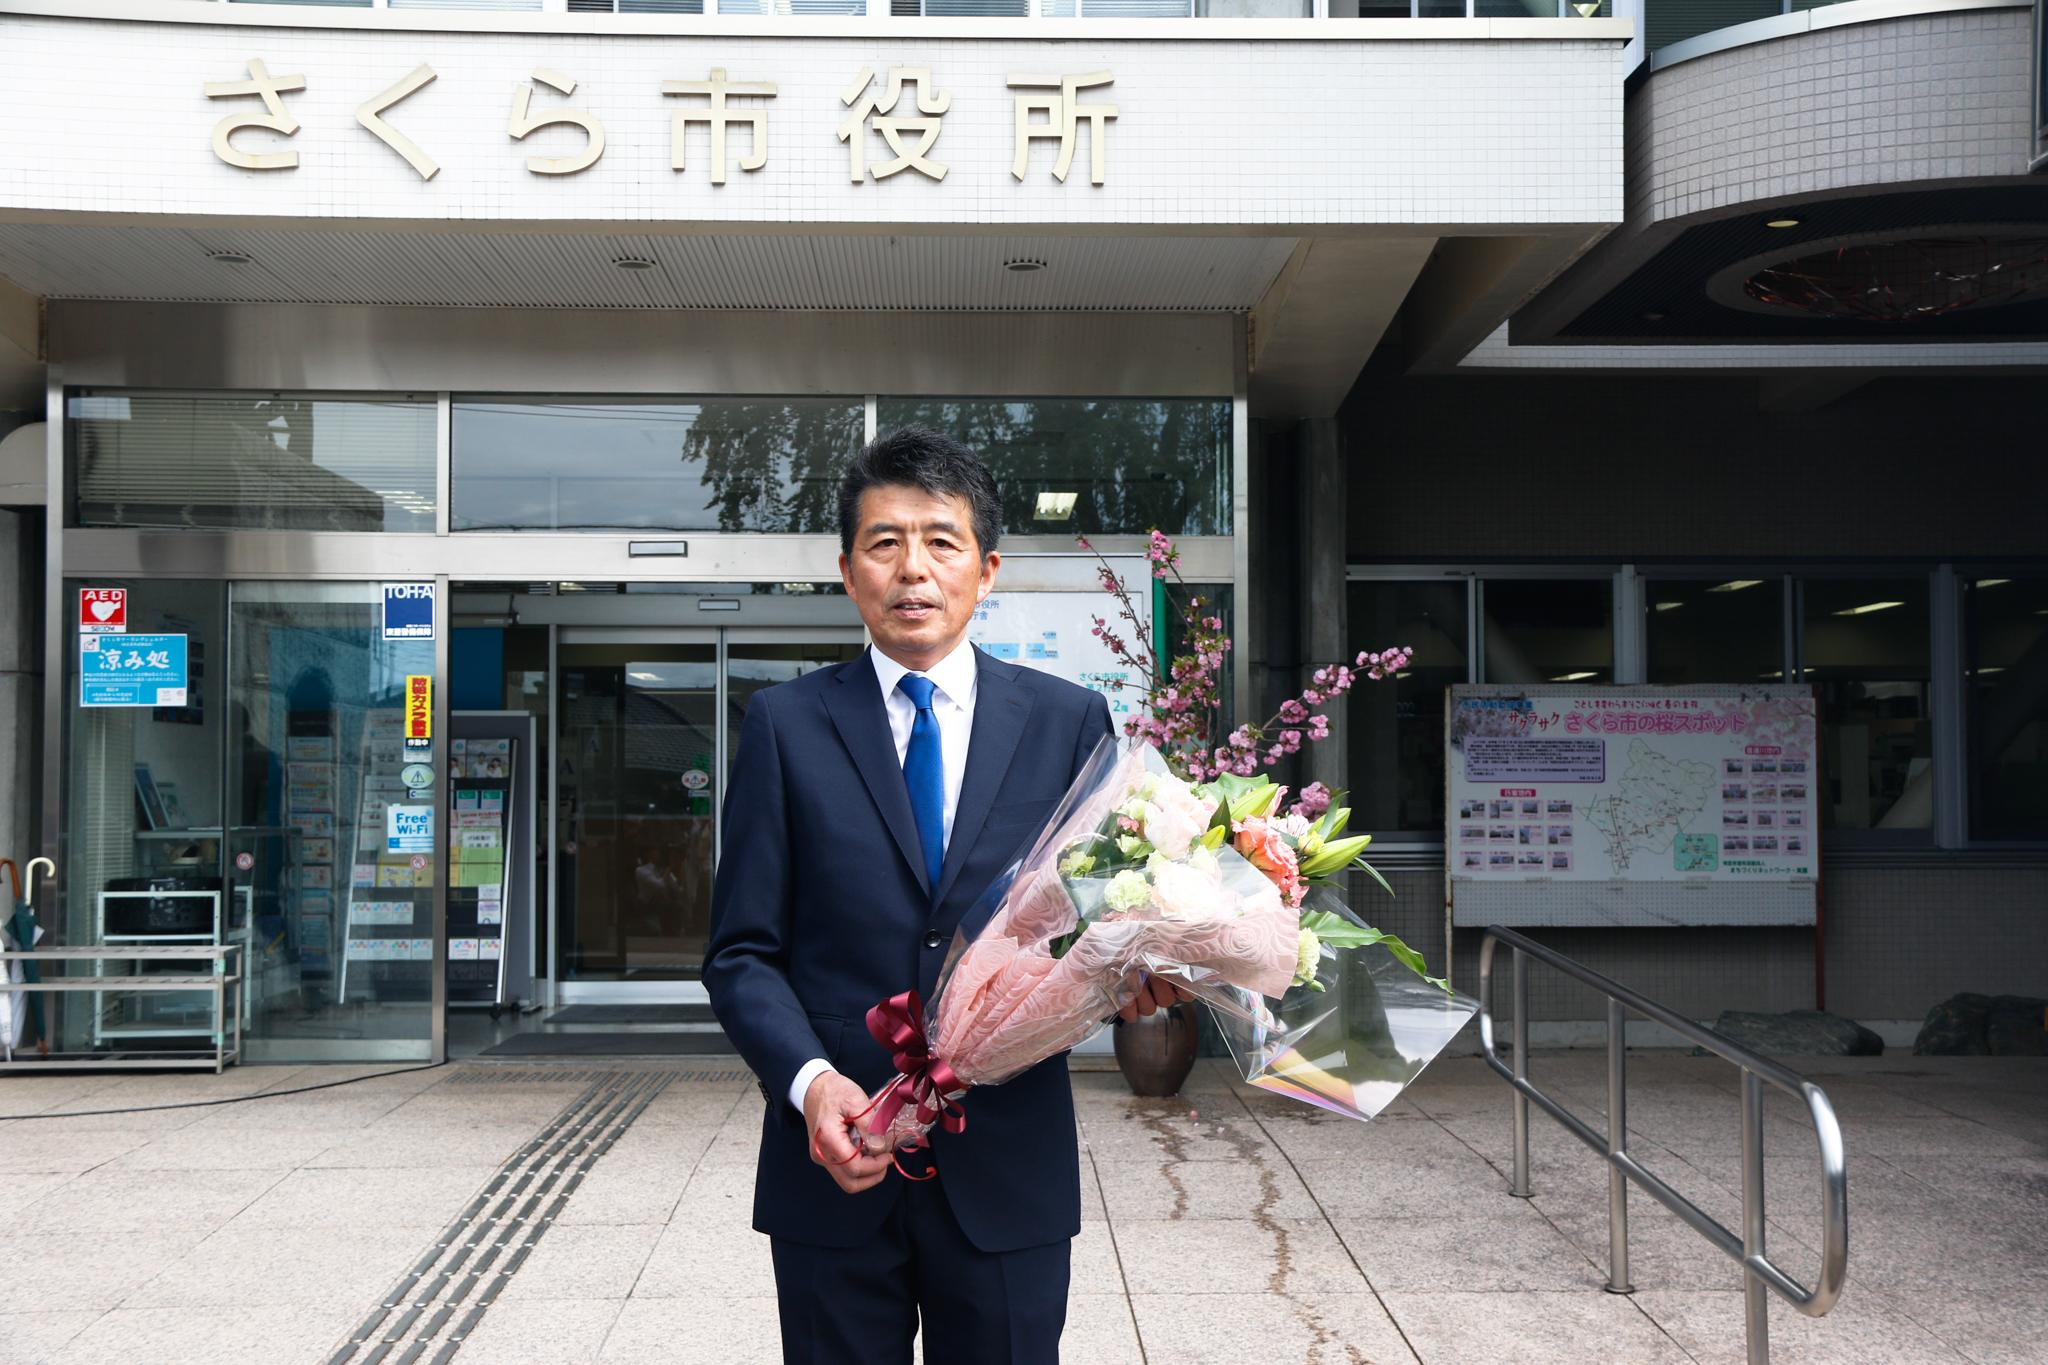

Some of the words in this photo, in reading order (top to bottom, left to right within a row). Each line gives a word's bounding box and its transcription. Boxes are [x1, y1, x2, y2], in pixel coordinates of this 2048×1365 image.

[204, 57, 1118, 185] さくら市役所
[84, 590, 122, 600] AED
[99, 649, 170, 671] 涼み処
[1565, 712, 1746, 734] さくら市の桜スポット
[396, 813, 427, 823] Free
[397, 825, 428, 834] Wi-Fi
